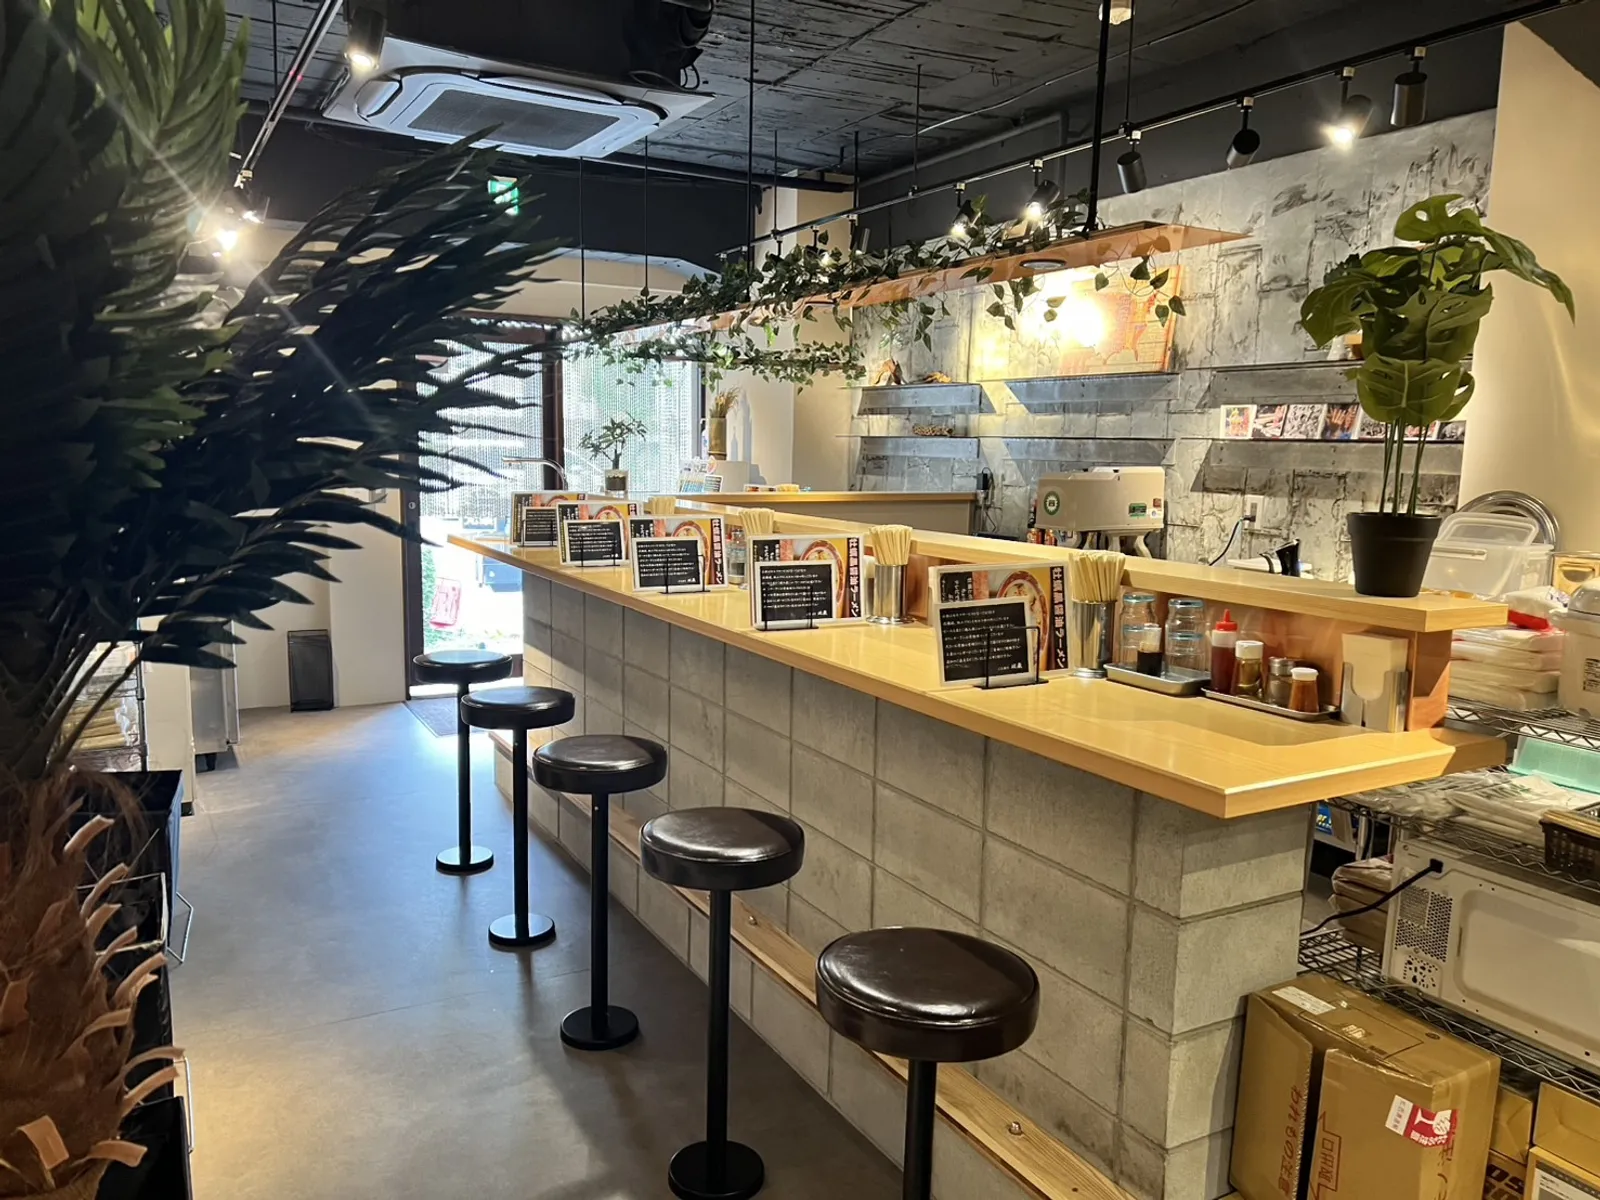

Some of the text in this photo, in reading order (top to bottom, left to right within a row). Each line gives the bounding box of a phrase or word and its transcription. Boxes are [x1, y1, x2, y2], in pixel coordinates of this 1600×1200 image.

[1278, 1085, 1303, 1195] われもの注意
[1318, 1137, 1336, 1183] 取出口
